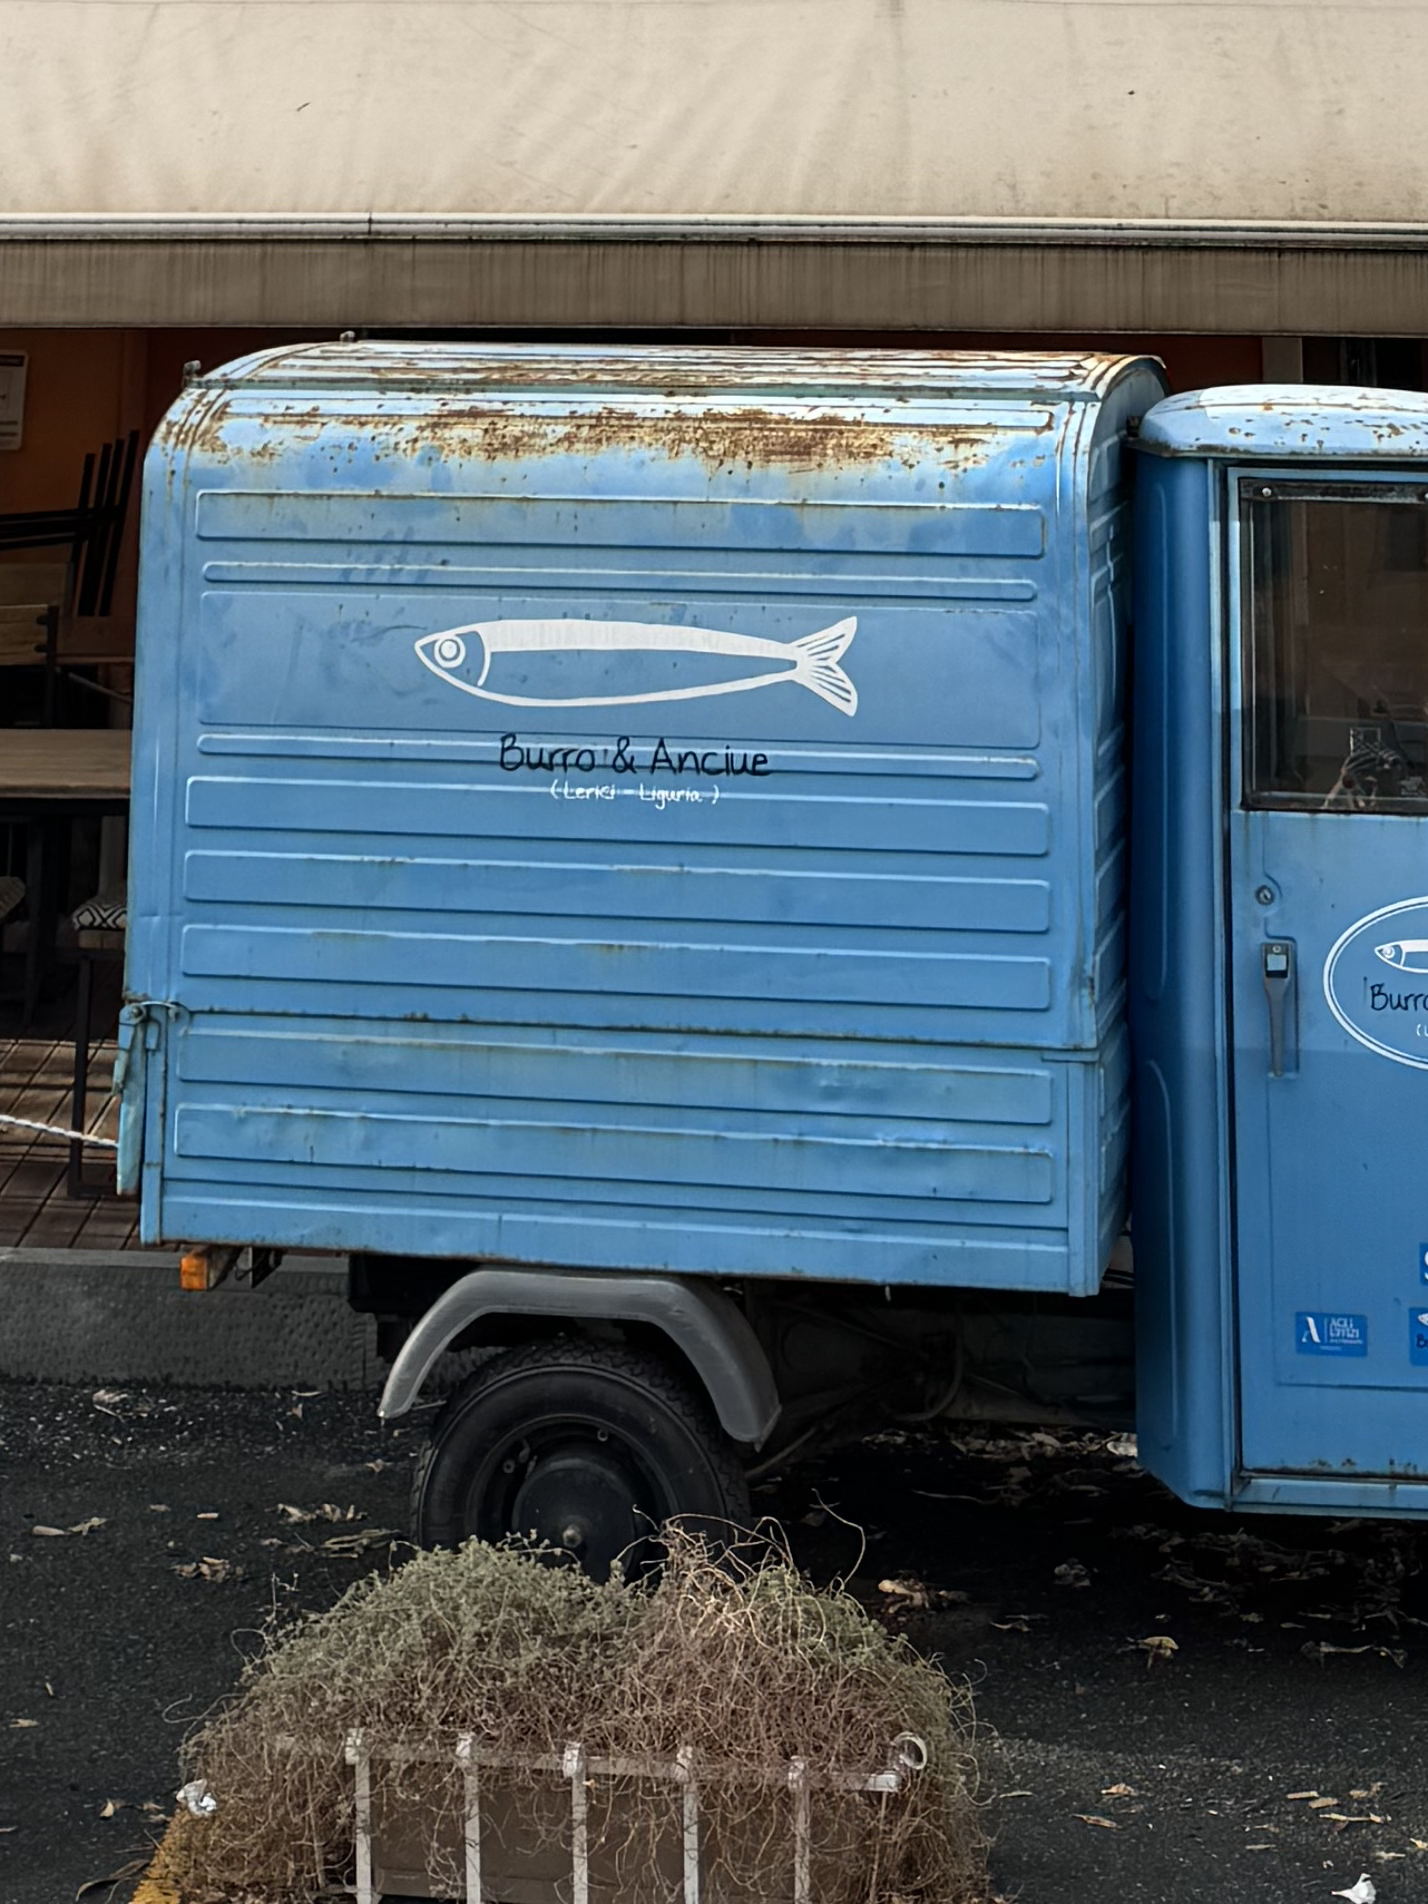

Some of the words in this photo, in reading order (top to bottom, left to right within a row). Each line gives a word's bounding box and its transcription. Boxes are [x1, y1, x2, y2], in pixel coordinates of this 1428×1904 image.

[500, 733, 596, 773] Burro
[612, 735, 638, 775] &
[650, 738, 772, 776] Anciue
